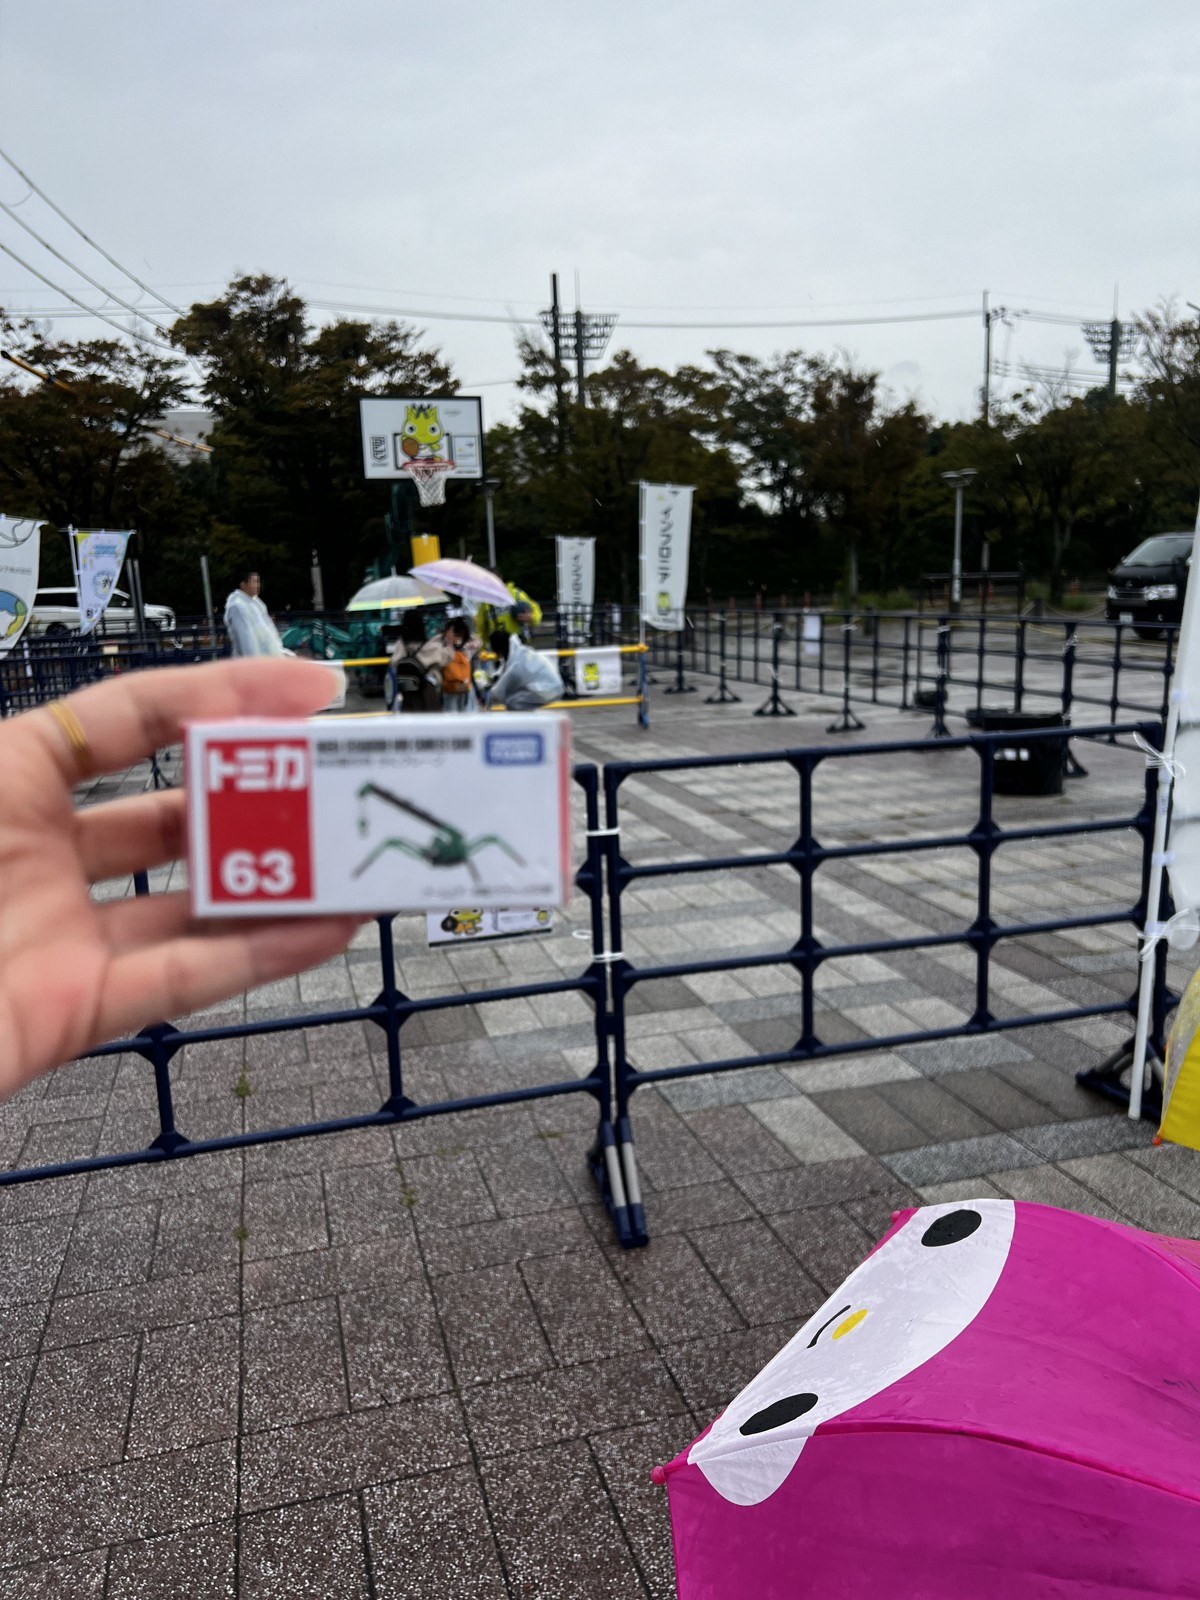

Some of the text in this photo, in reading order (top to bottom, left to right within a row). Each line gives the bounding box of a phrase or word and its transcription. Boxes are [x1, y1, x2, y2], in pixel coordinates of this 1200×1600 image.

[207, 747, 307, 792] トミカ
[221, 849, 295, 894] 63
